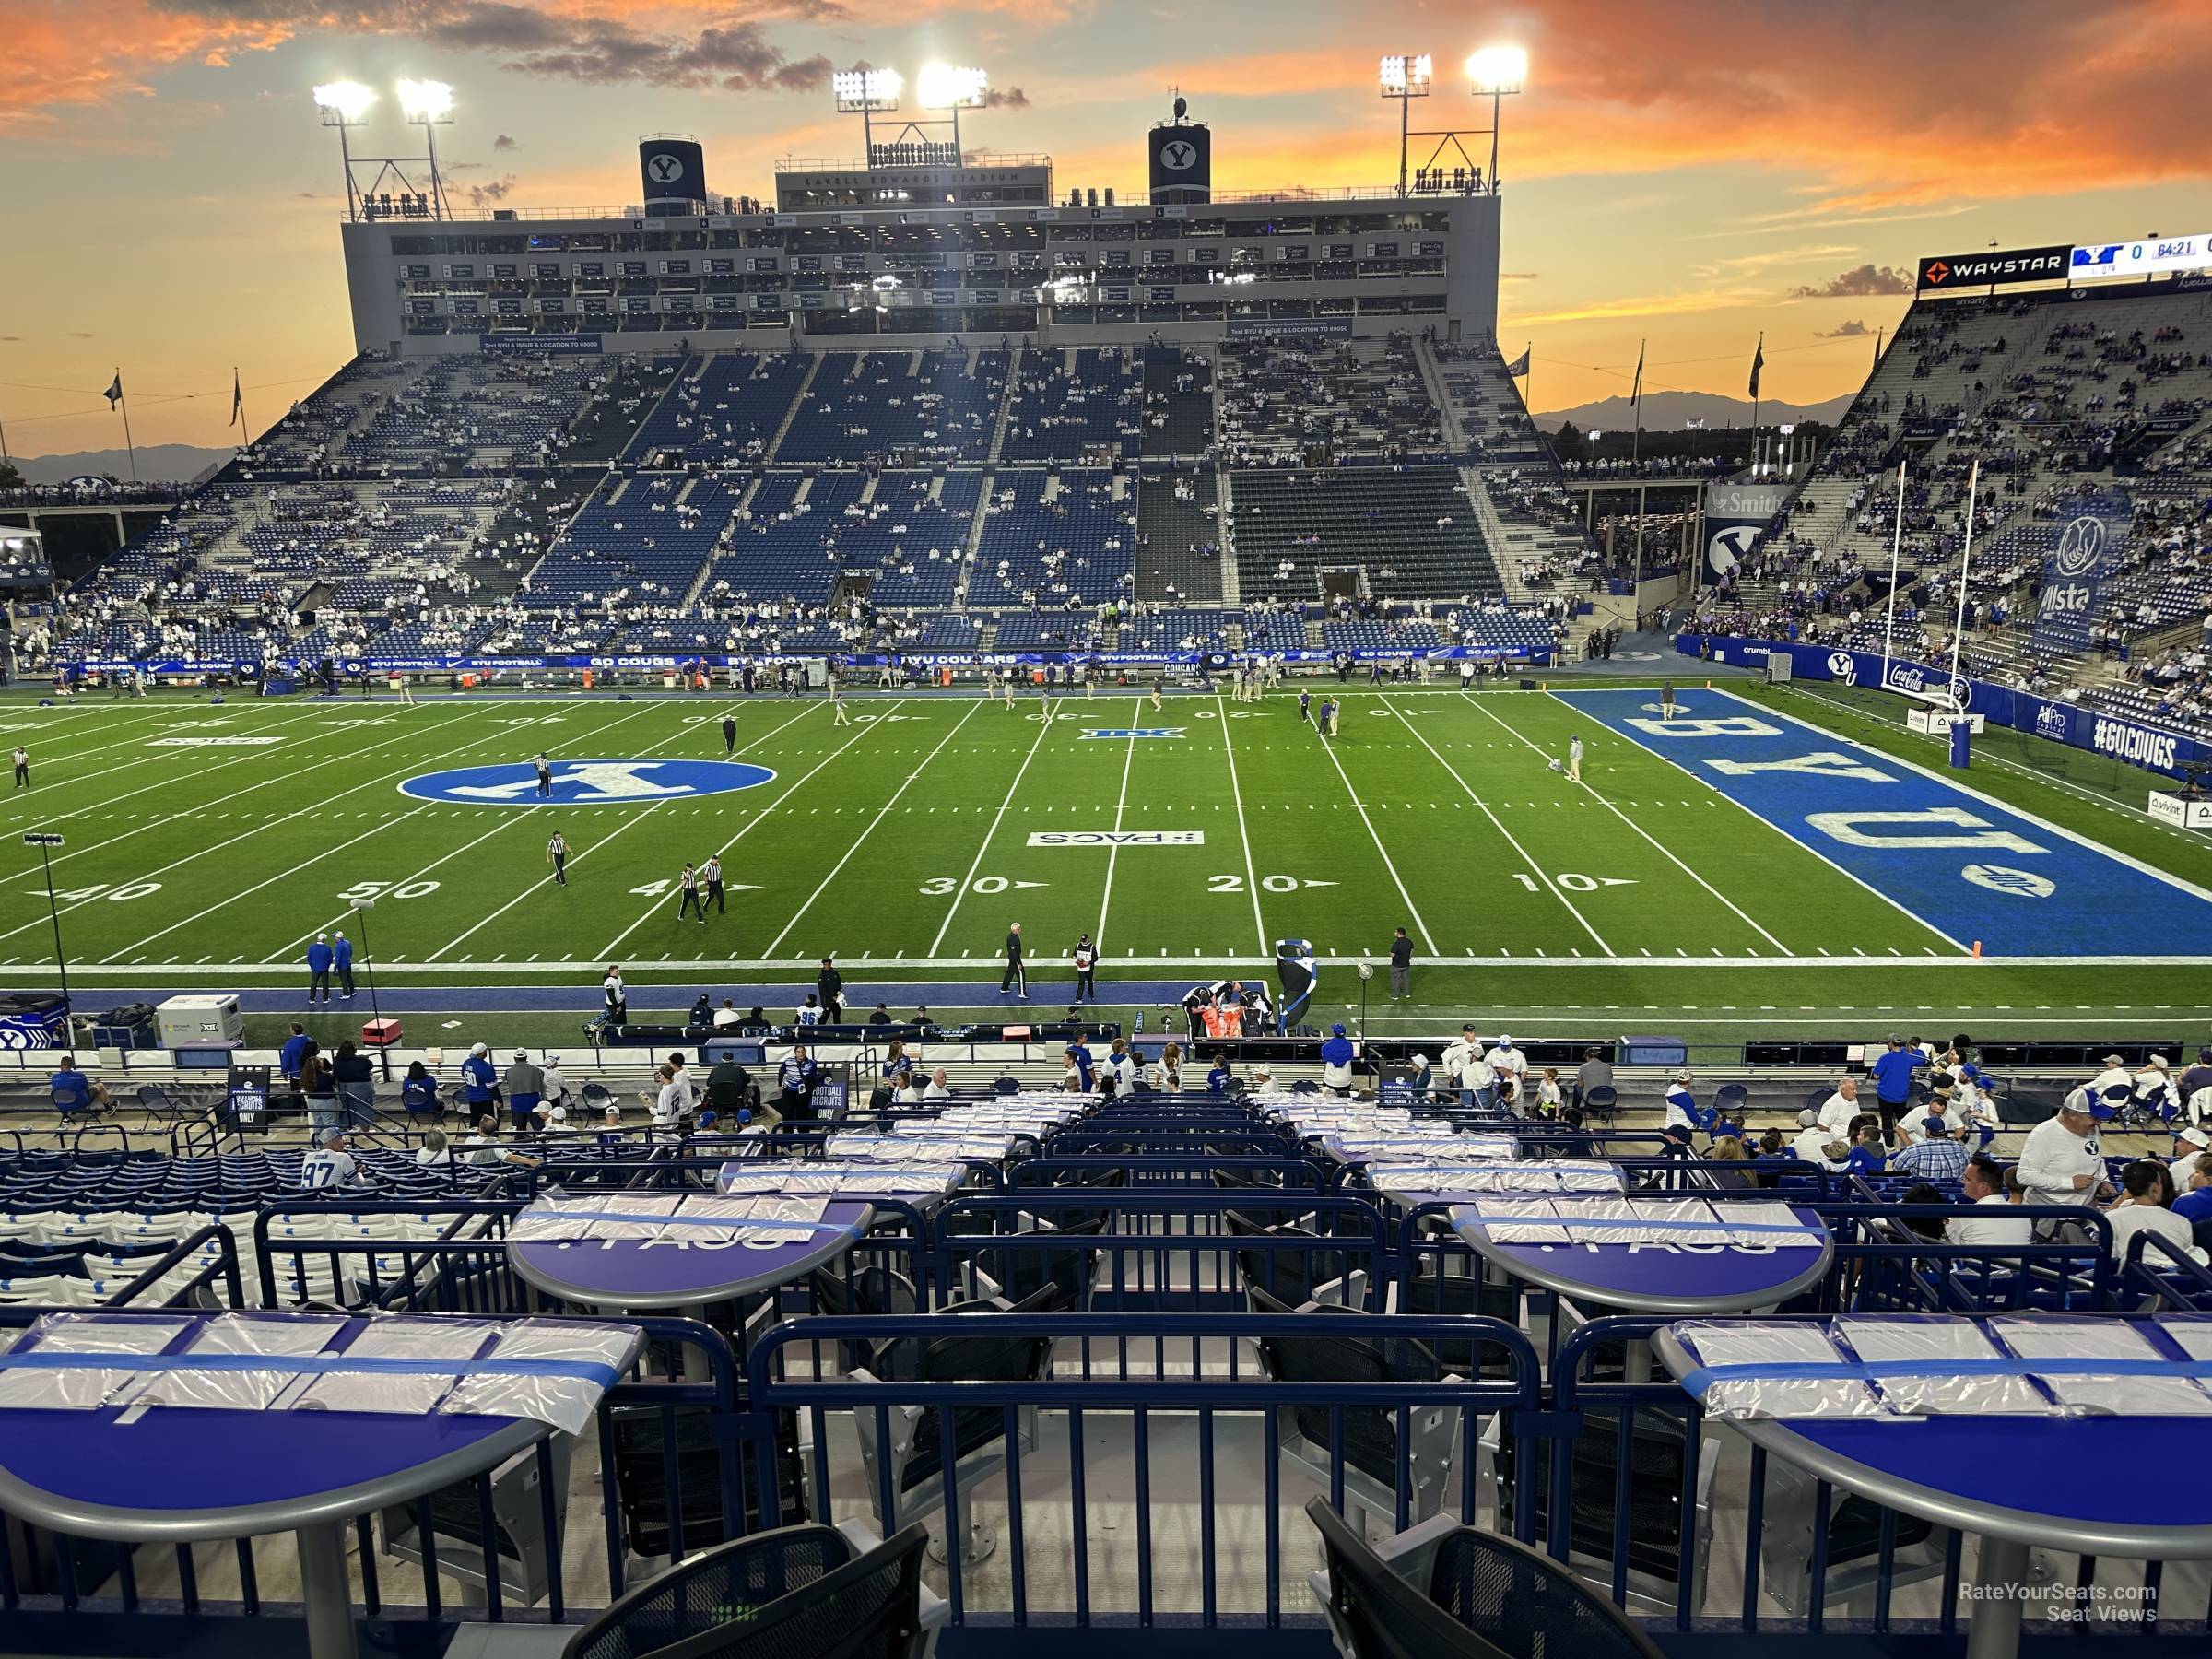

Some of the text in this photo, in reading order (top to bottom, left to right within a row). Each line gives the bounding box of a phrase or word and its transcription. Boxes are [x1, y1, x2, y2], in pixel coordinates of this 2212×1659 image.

[1166, 144, 1191, 166] Y
[652, 158, 677, 180] Y
[871, 175, 940, 184] EDWARDS
[951, 173, 1018, 182] STADIUM
[2132, 245, 2143, 259] 0
[2158, 241, 2192, 257] 64:21
[1953, 256, 2061, 276] WAYSTAR
[590, 657, 676, 666] GO COUGS
[2094, 718, 2176, 770] #GOCOUGS
[2159, 801, 2180, 815] vivint
[1039, 832, 1163, 844] PACS
[337, 881, 441, 899] 50
[919, 877, 1009, 895] 30
[1207, 875, 1299, 892] 20
[1512, 873, 1600, 892] 10
[53, 883, 163, 901] 40
[801, 1012, 816, 1025] 96
[464, 1070, 477, 1087] 90
[1113, 1069, 1122, 1084] 4
[812, 1096, 842, 1106] RECRUITS
[239, 1112, 255, 1123] ONLY
[818, 1109, 834, 1118] ONLY
[304, 1163, 335, 1187] 97
